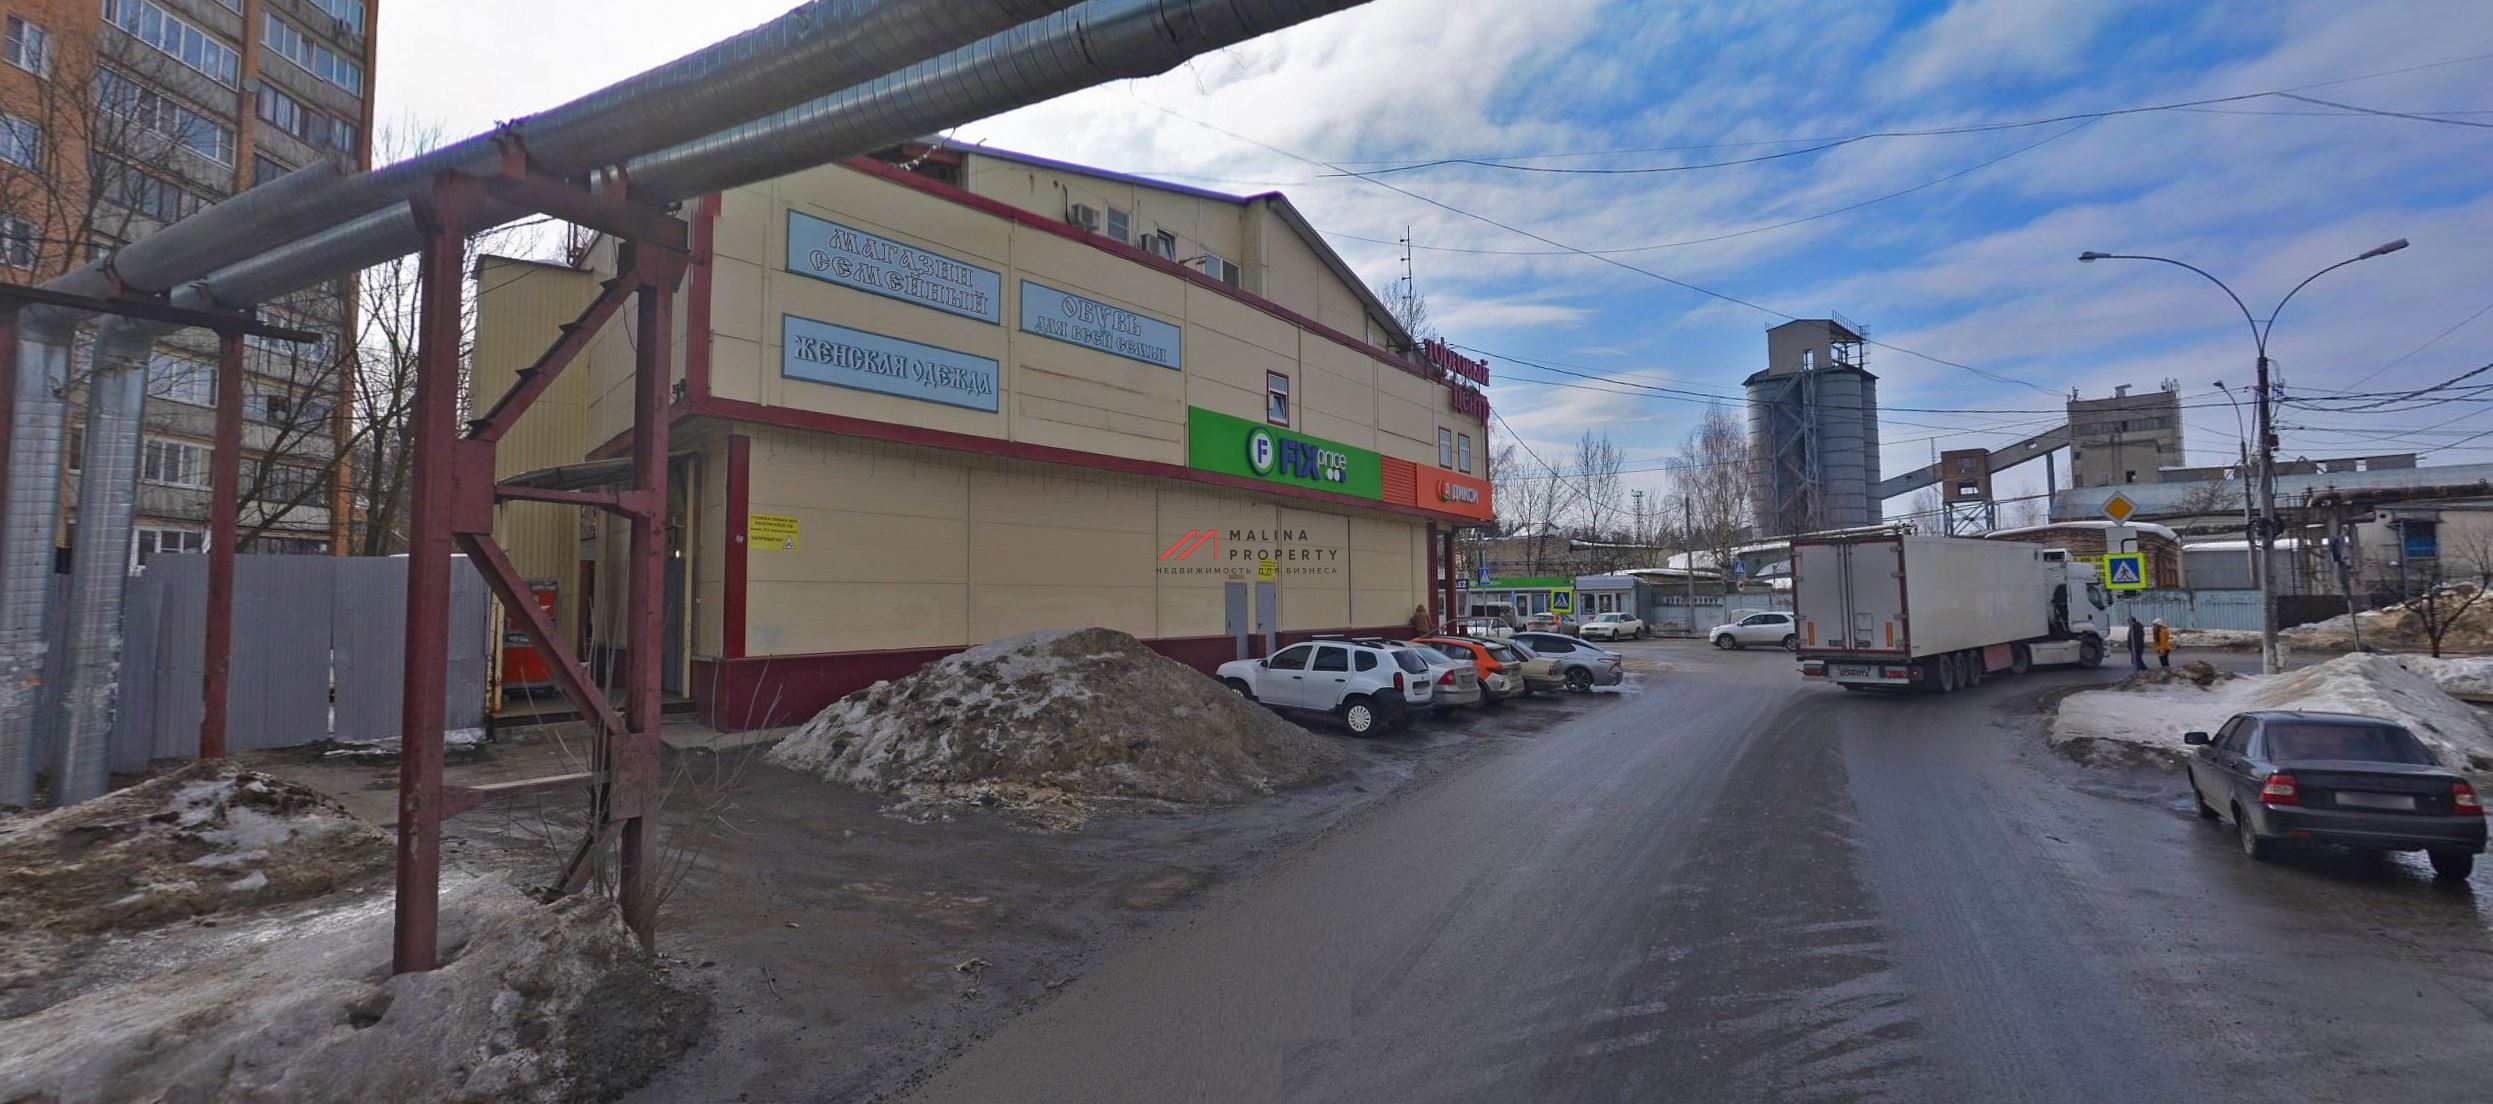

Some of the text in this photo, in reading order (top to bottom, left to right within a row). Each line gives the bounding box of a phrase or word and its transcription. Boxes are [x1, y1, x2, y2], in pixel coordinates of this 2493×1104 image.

[809, 250, 988, 315] СЕМЕЙНЫЙ
[829, 228, 974, 288] МАГАЗИН
[1035, 315, 1167, 363] ДЛЯ ВСЕЙ СЕМЬИ
[1062, 296, 1141, 336] ОБУВЬ
[794, 335, 992, 397] ЖЕНСКАЯ ОДЕЖДА
[1279, 437, 1347, 481] FIX price
